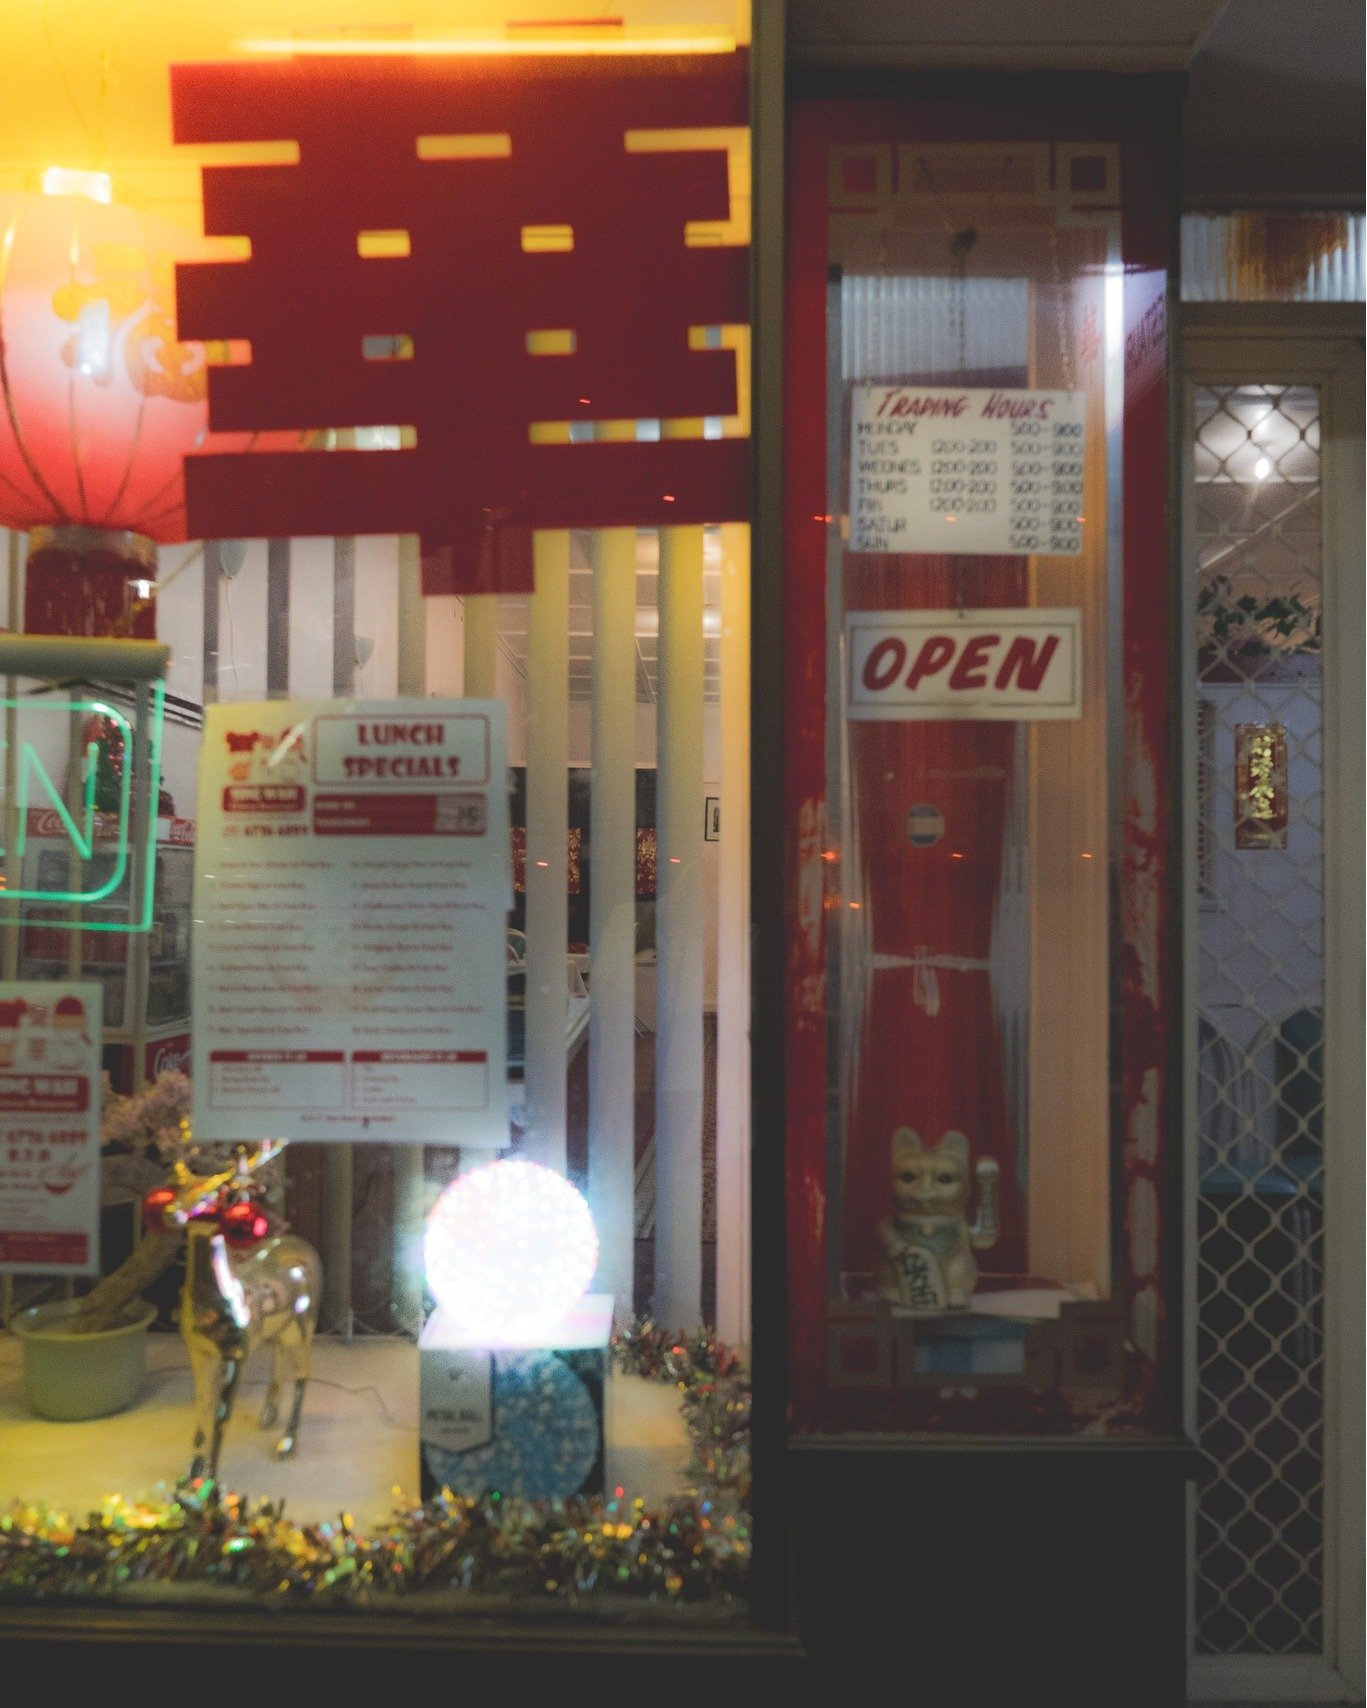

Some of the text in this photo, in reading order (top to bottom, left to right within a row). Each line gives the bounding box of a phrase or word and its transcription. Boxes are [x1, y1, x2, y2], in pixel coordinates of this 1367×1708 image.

[876, 387, 1055, 419] TRADING HOURS
[857, 421, 918, 435] MONDAY
[859, 439, 899, 455] TUES
[858, 460, 921, 475] WEDNES
[859, 479, 908, 494] THURS
[862, 634, 1060, 693] OPEN
[357, 722, 445, 746] LUNCH
[342, 755, 460, 778] SPECIALS
